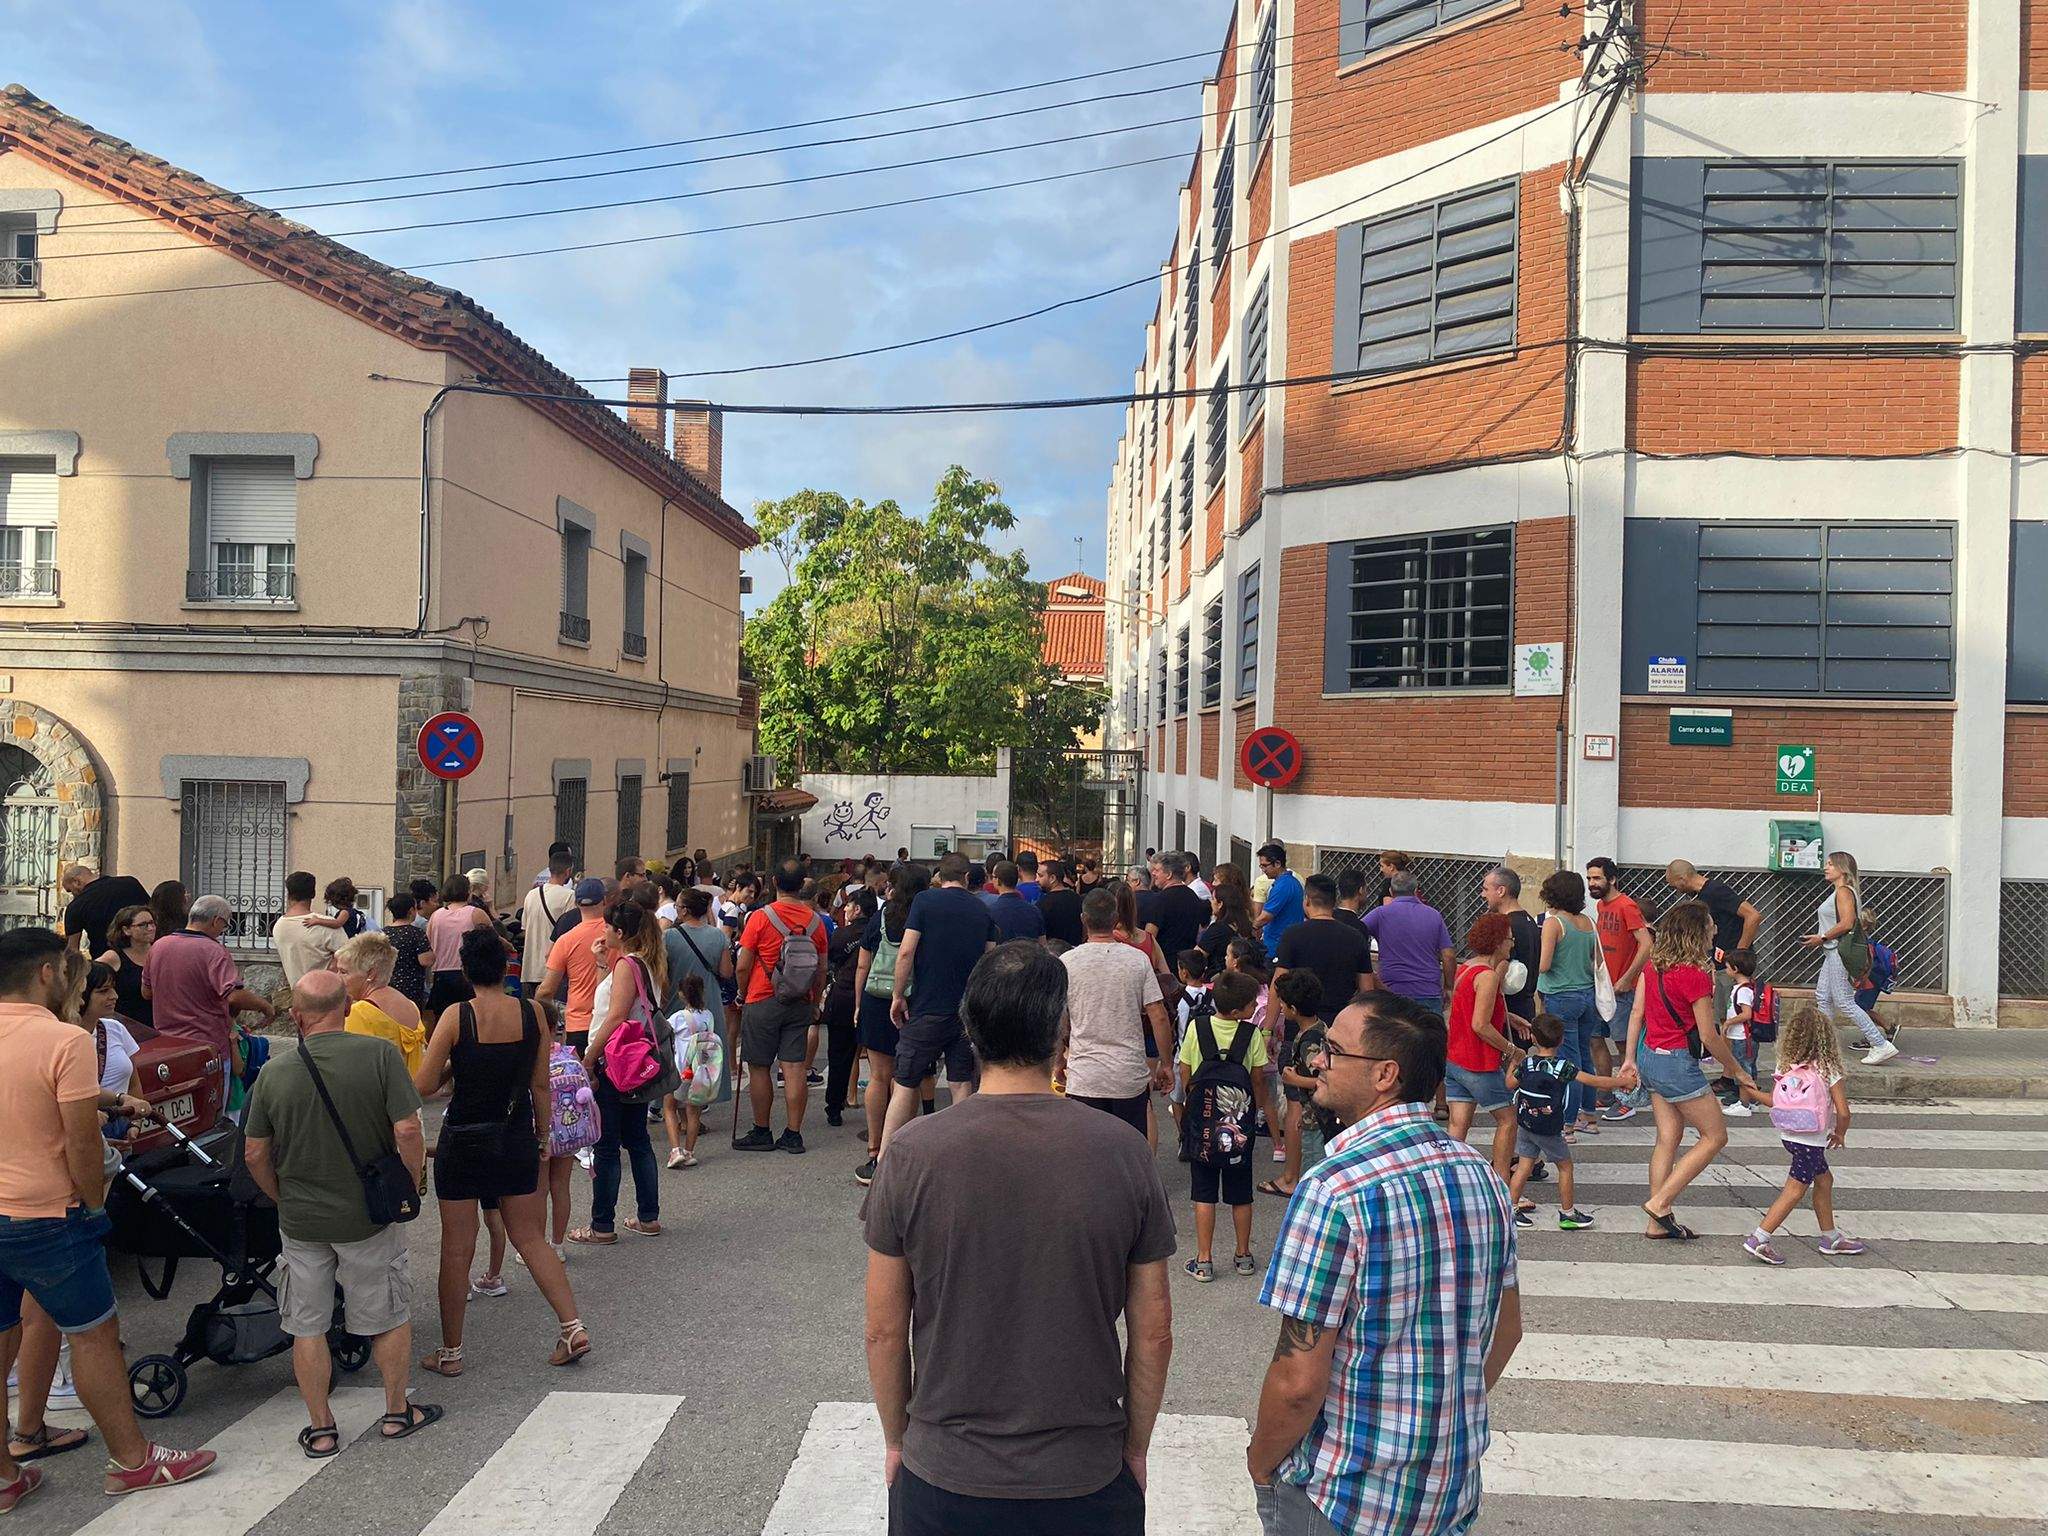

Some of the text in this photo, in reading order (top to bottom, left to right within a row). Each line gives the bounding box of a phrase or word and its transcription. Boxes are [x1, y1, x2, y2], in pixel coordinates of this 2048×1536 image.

[1678, 725, 1695, 733] Carrer
[1781, 782, 1808, 792] DEA
[1204, 1088, 1213, 1096] Z
[171, 1096, 192, 1118] DCJ
[1203, 1097, 1212, 1118] Ball
